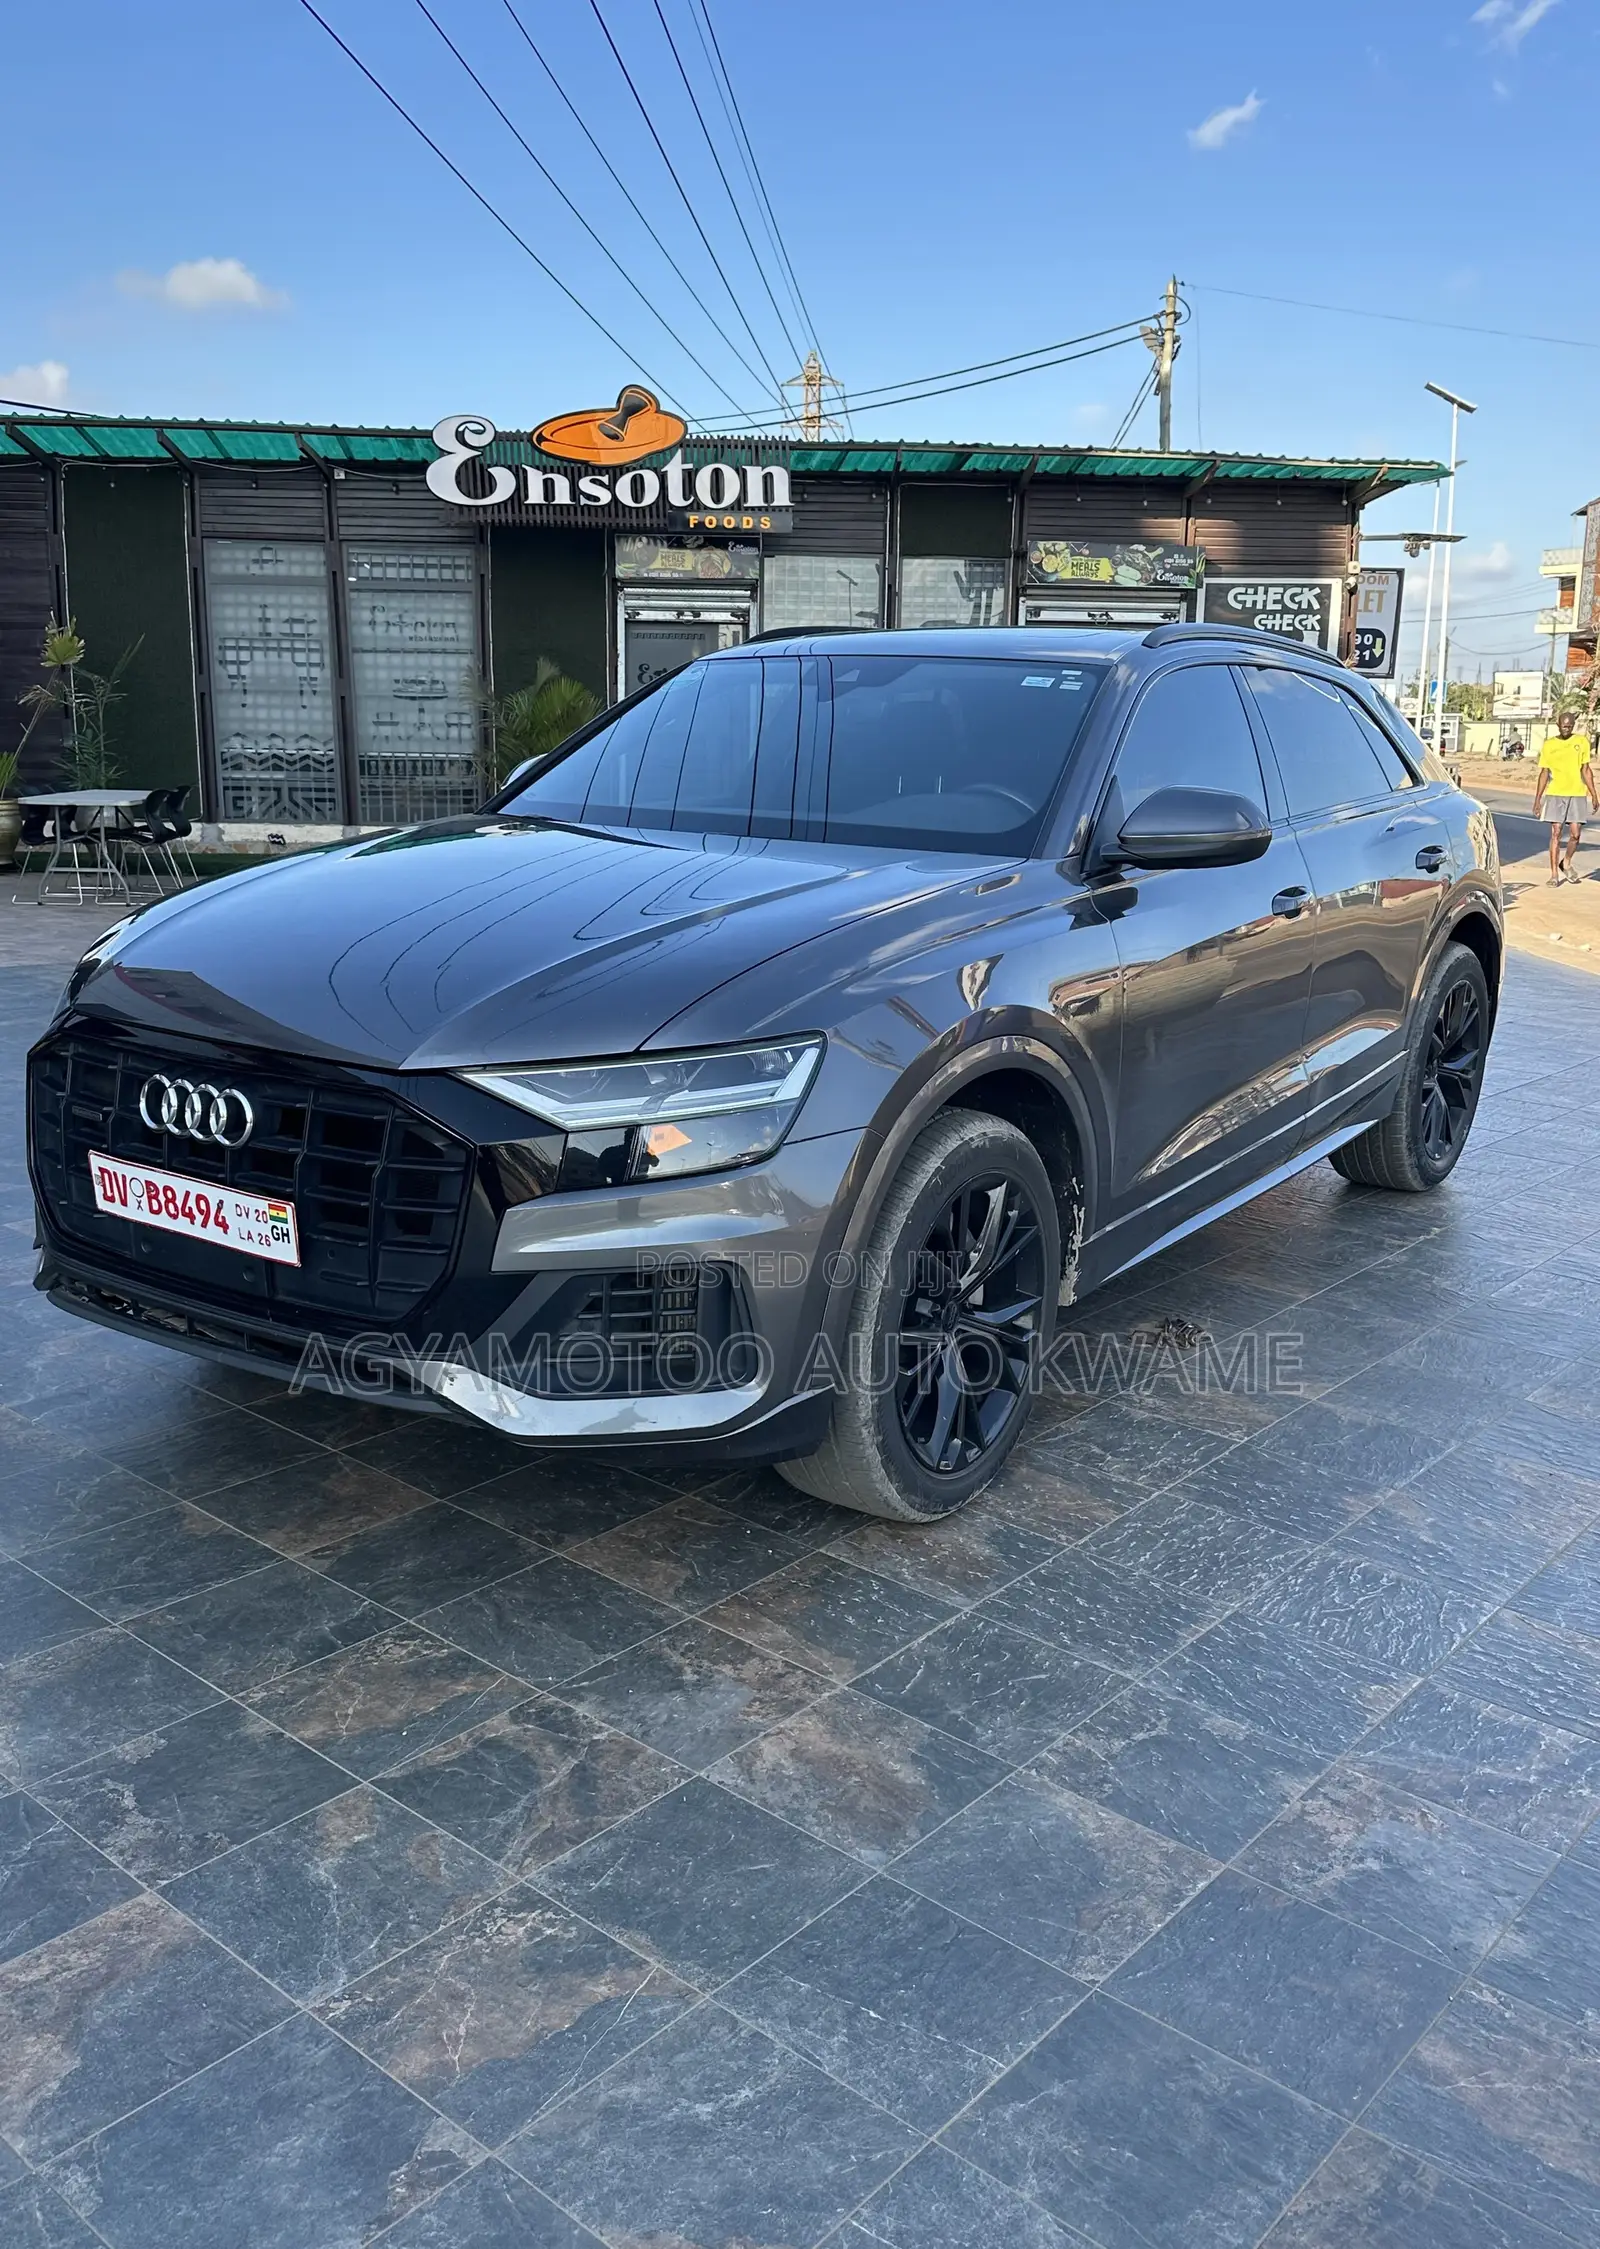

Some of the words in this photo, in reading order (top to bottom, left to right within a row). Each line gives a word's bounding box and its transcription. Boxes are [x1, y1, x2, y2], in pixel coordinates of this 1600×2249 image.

[425, 415, 795, 509] Ensoton
[689, 515, 771, 529] FOODS
[1071, 561, 1100, 571] MEALS
[1357, 575, 1389, 585] OOM
[1227, 586, 1321, 610] CHECK
[1253, 613, 1321, 631] CHECK
[98, 1166, 128, 1207] DV
[144, 1180, 230, 1235] B8494
[235, 1203, 250, 1219] DV
[254, 1209, 268, 1224] 20
[238, 1227, 255, 1243] LA
[257, 1232, 271, 1247] 26
[270, 1225, 291, 1244] GH
